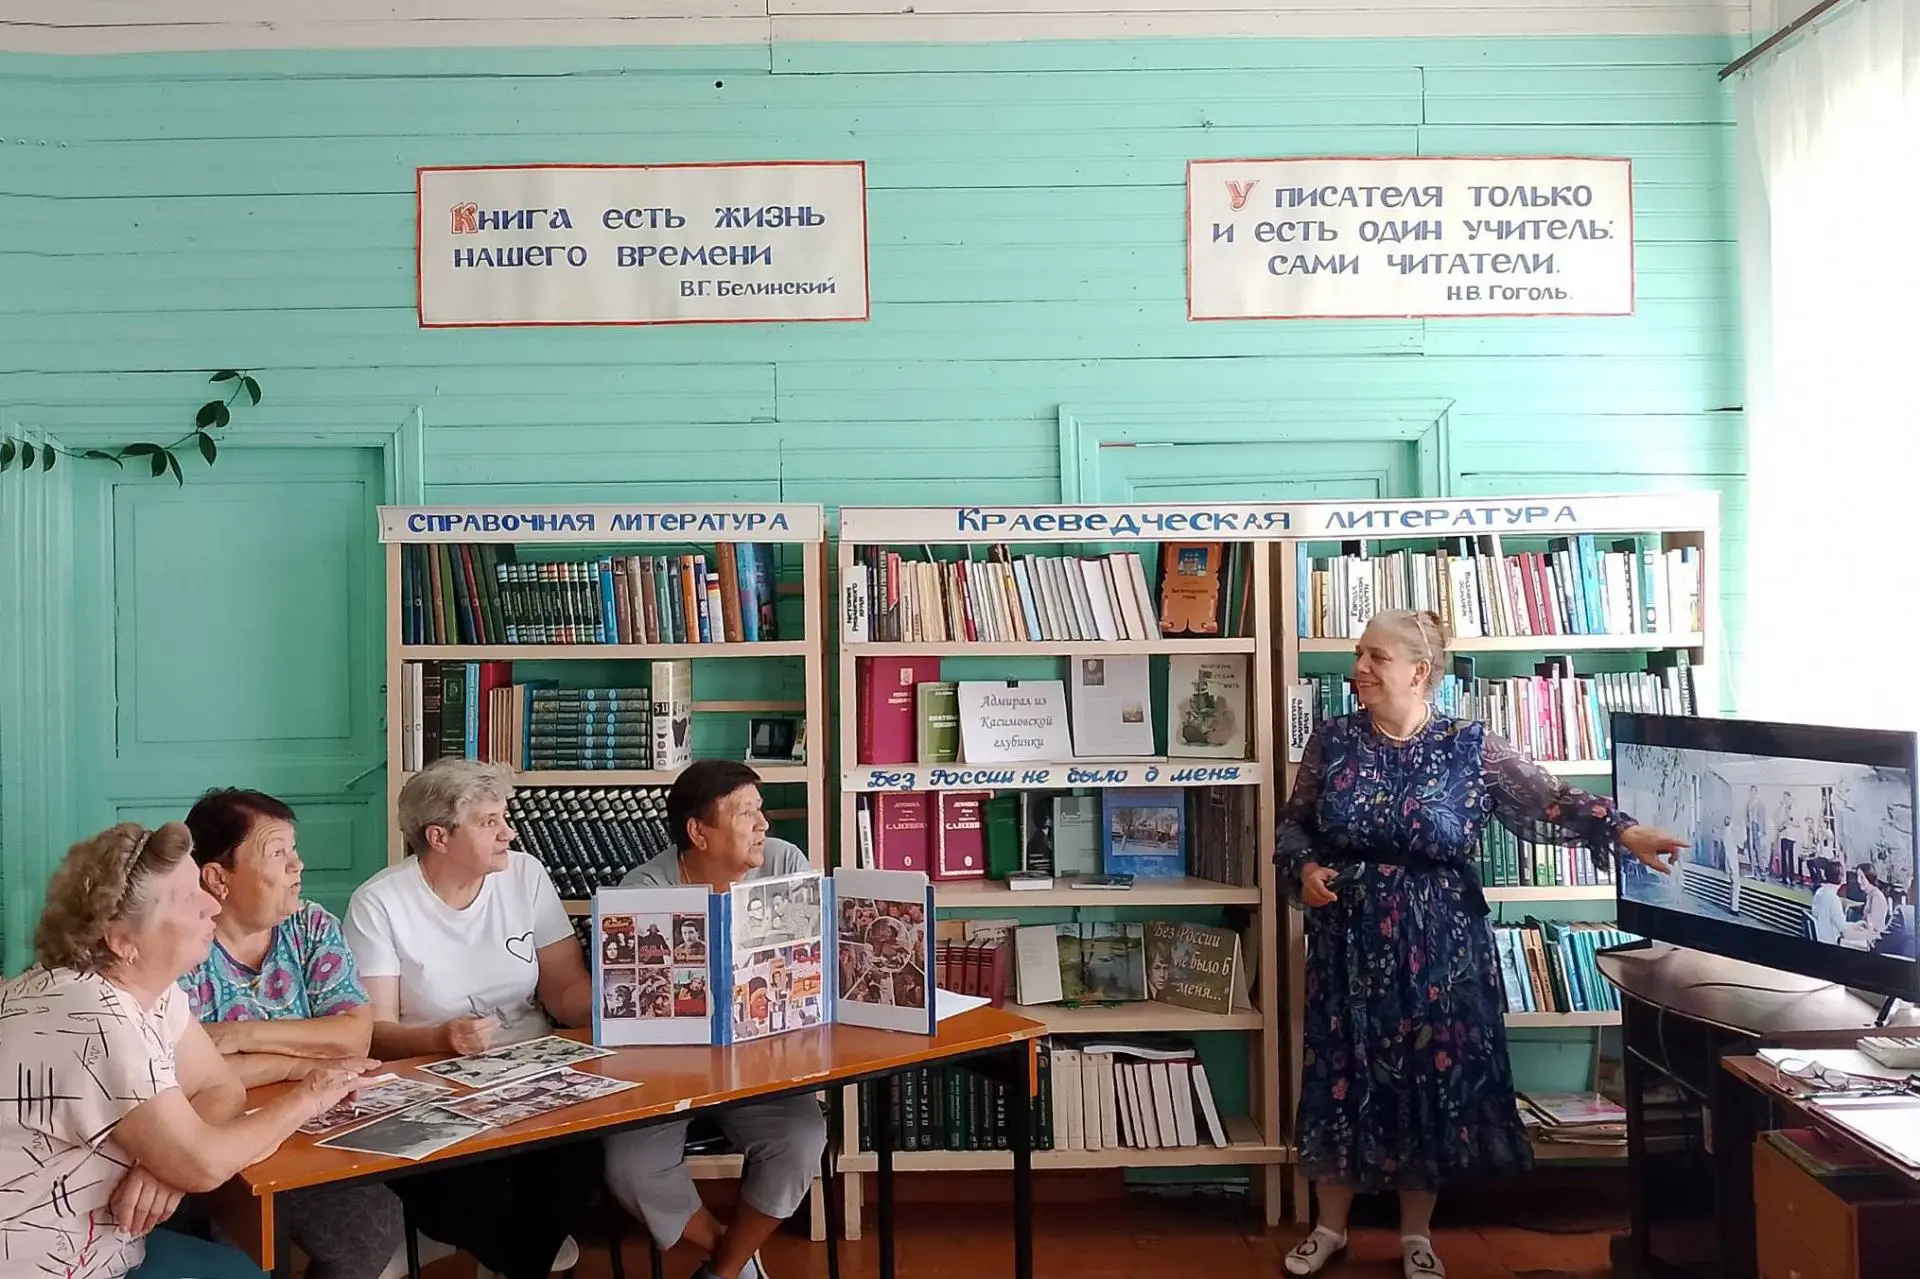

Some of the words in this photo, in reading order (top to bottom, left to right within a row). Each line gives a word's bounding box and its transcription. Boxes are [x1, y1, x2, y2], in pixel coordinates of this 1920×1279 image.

[1223, 179, 1259, 213] У
[716, 275, 837, 297] Белинский
[407, 512, 596, 533] СПРАВОЧНАЯ
[609, 511, 790, 533] ЛИТЕРАТУРА
[980, 693, 1031, 709] Адмирал
[1034, 696, 1048, 706] из
[980, 715, 1054, 729] Касимовской
[993, 734, 1045, 752] глубинки
[867, 769, 916, 792] Без
[929, 768, 1018, 787] России
[1020, 768, 1051, 785] не
[1169, 766, 1241, 782] меня
